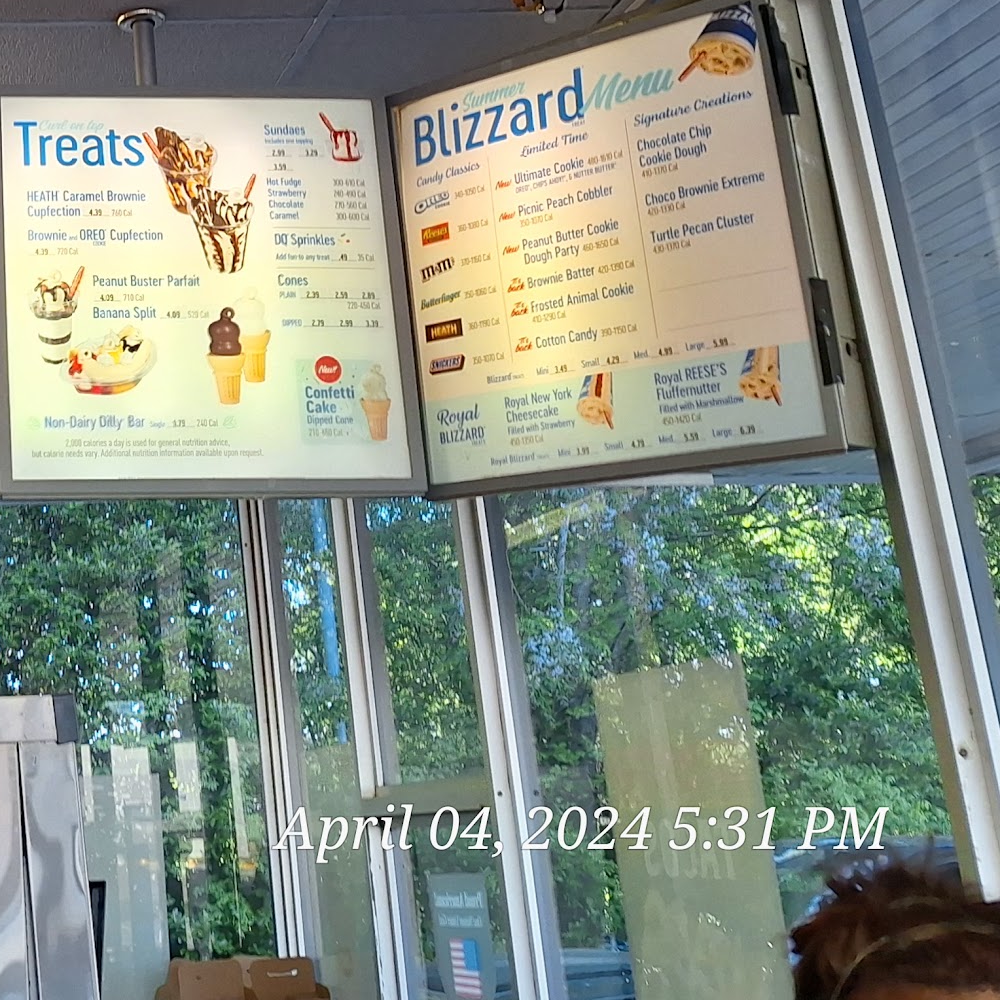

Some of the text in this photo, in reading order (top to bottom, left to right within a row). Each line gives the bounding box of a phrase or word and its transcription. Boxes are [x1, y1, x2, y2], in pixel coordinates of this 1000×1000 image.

[462, 81, 527, 112] Summer
[414, 67, 674, 167] Blizzard Menu
[634, 89, 753, 127] Signature Creations
[264, 125, 305, 136] Sundaes
[637, 125, 712, 151] Chocolate Chip
[13, 121, 145, 166] Treats
[520, 131, 589, 158] Limited Time
[639, 142, 707, 167] Cookie Dough
[416, 162, 480, 188] Candy Classics
[514, 157, 584, 185] Ultimate Cookie
[266, 178, 301, 187] Hot Fudge
[645, 171, 765, 207] Choco Brownie Extreme
[27, 190, 146, 202] HEATH Caramel Brownie
[268, 189, 306, 199] Strawberry
[518, 185, 613, 216] Picnic Peach Cobbler
[27, 205, 81, 219] Cupfection
[269, 200, 304, 208] Chocolate
[269, 211, 299, 220] Caramel
[28, 229, 67, 241] Brownie
[79, 229, 105, 241] OREO
[110, 228, 163, 243] Cupfection
[522, 219, 619, 250] Peanut Butter Cookie
[650, 213, 755, 244] Turtle Pecan Cluster
[275, 233, 335, 248] DQ Sprinkles
[524, 244, 580, 265] Dough Party
[93, 275, 200, 287] Peanut Buster Parfait
[278, 274, 308, 286] Cones
[527, 267, 595, 289] Brownie Batter
[306, 291, 348, 299] 2.39 2.59
[530, 282, 634, 313] Frosted Animal Cookie
[93, 307, 130, 319] Banana
[134, 307, 156, 320] Split
[535, 327, 598, 349] Cotton Candy
[685, 341, 705, 353] Large
[555, 364, 568, 373] 3.49
[581, 356, 620, 368] Small 4.29
[654, 362, 728, 386] Royal REESE'S
[305, 385, 355, 399] Confetti
[504, 387, 572, 411] Royal New York
[656, 382, 721, 401] Fluffernutter
[306, 400, 336, 413] Cake
[437, 403, 480, 429] Royal
[506, 406, 559, 423] Cheesecake
[44, 415, 96, 431] Non-Dairy
[128, 416, 145, 427] Bar
[307, 415, 353, 426] Dipped Cone
[440, 426, 485, 445] BLIZZARD
